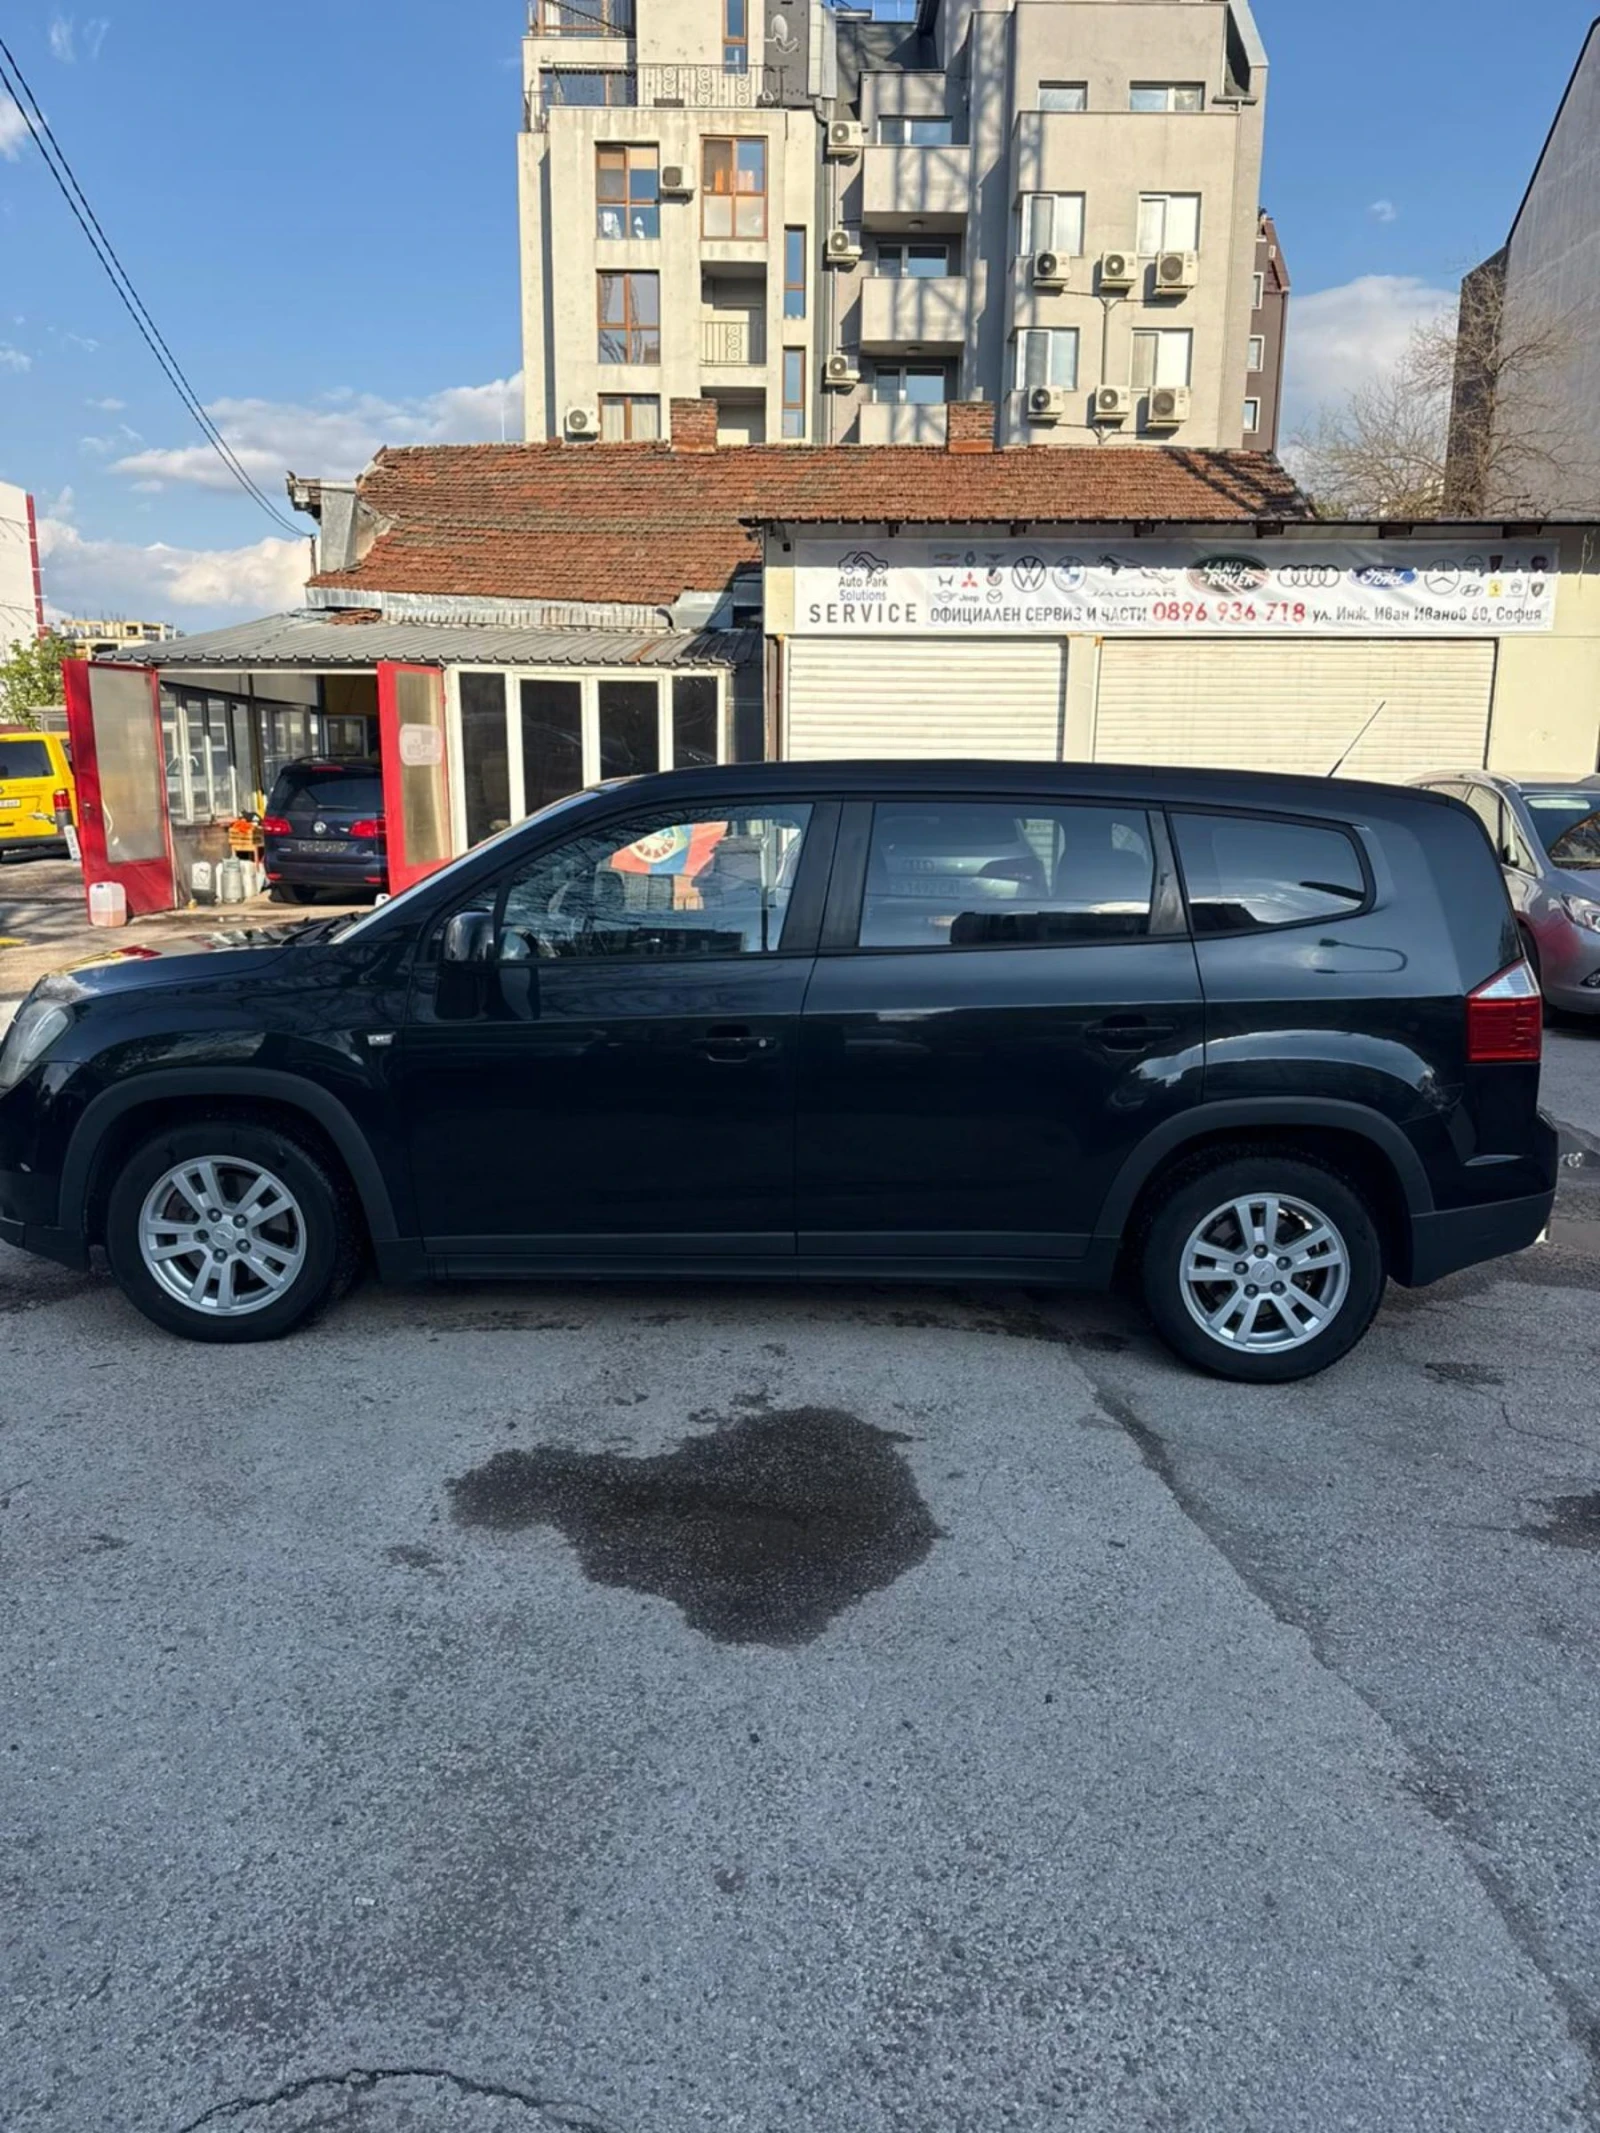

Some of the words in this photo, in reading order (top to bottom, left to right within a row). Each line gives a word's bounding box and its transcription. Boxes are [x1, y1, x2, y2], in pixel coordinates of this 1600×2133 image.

[1205, 560, 1244, 574] LAND
[838, 576, 863, 588] Auto
[865, 576, 888, 588] Park
[1206, 570, 1255, 586] ROVER
[839, 589, 887, 602] Solutions
[809, 603, 917, 623] SERVICE
[930, 606, 1021, 624] ОФИЦИАЛЕН
[1025, 606, 1082, 621] СЕРВИЗ
[1087, 606, 1097, 621] И
[1101, 606, 1148, 621] ЧАСТИ
[1153, 601, 1208, 621] 0896
[1217, 601, 1256, 621] 936
[1265, 602, 1306, 623] 718
[1313, 610, 1332, 623] ул.
[1375, 606, 1409, 621] Иван
[1496, 606, 1542, 623] София
